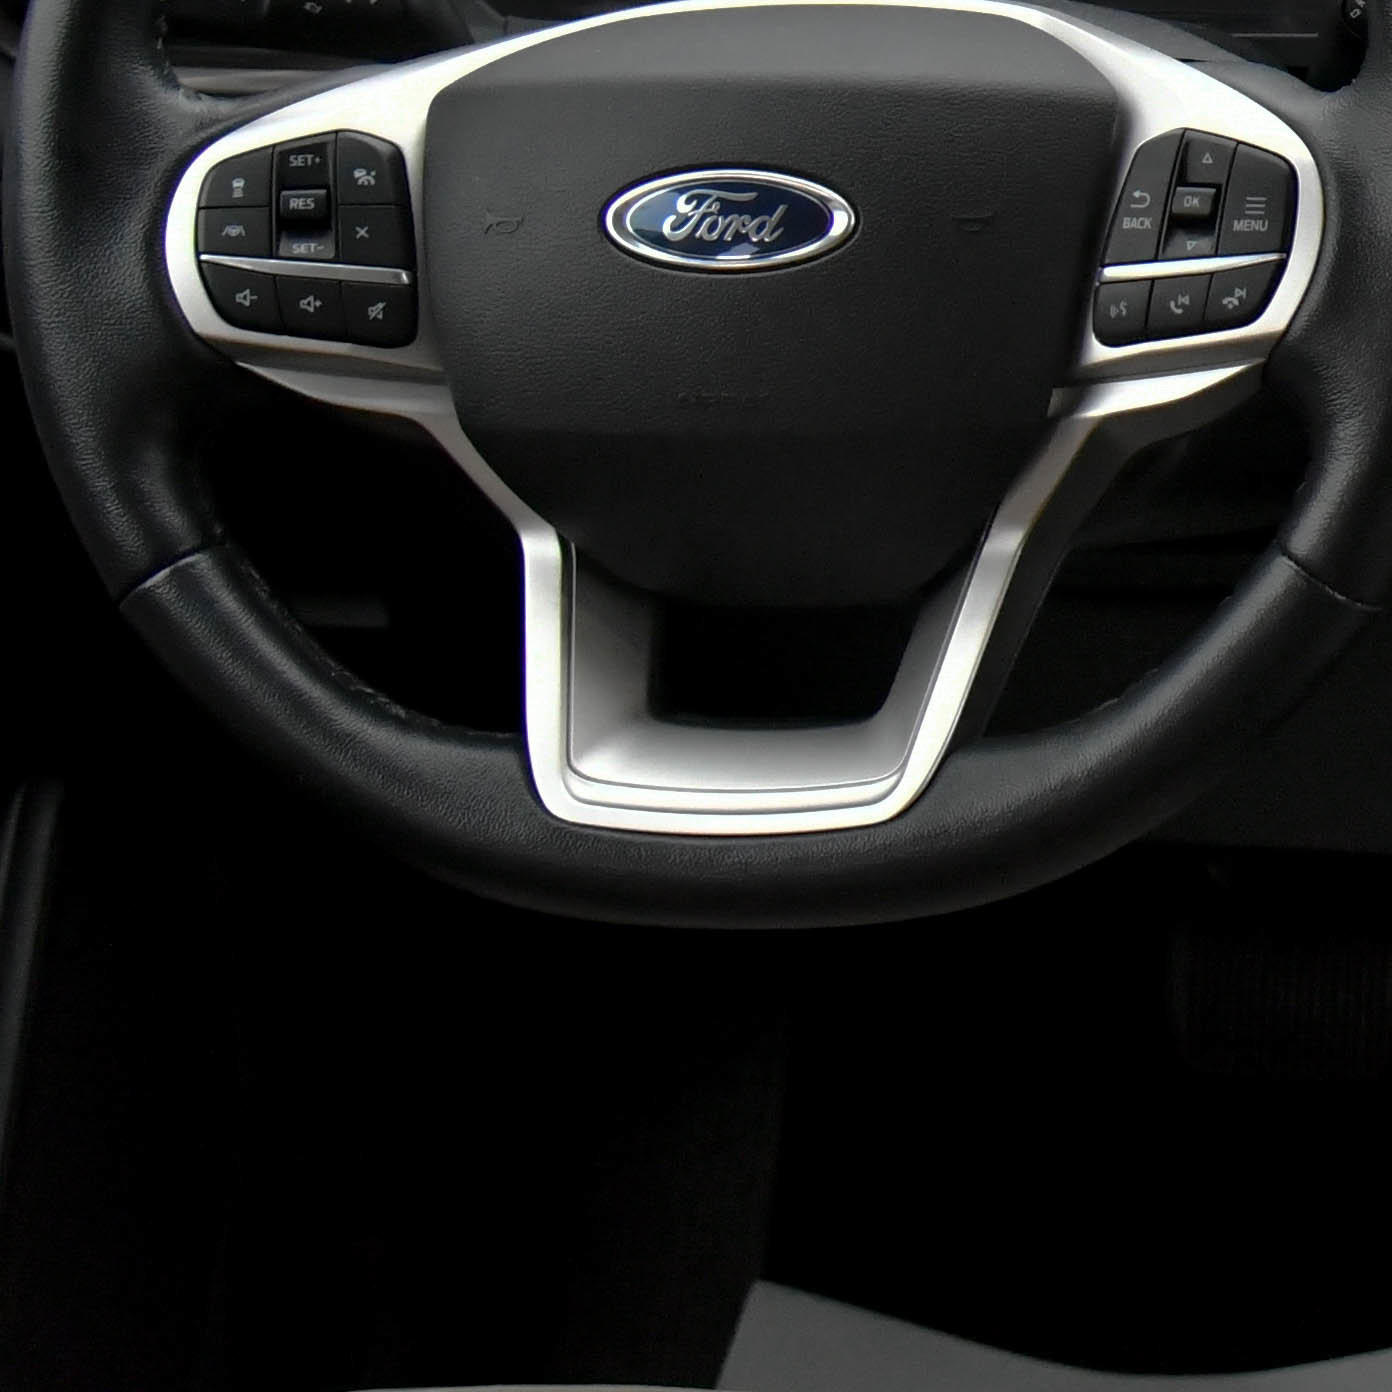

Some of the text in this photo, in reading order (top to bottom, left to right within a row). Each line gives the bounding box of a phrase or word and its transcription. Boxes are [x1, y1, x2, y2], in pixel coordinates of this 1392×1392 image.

[289, 197, 315, 210] RES
[1183, 196, 1200, 208] OK
[662, 188, 788, 242] Ford
[1122, 217, 1152, 230] BACK
[1232, 219, 1268, 233] MENU
